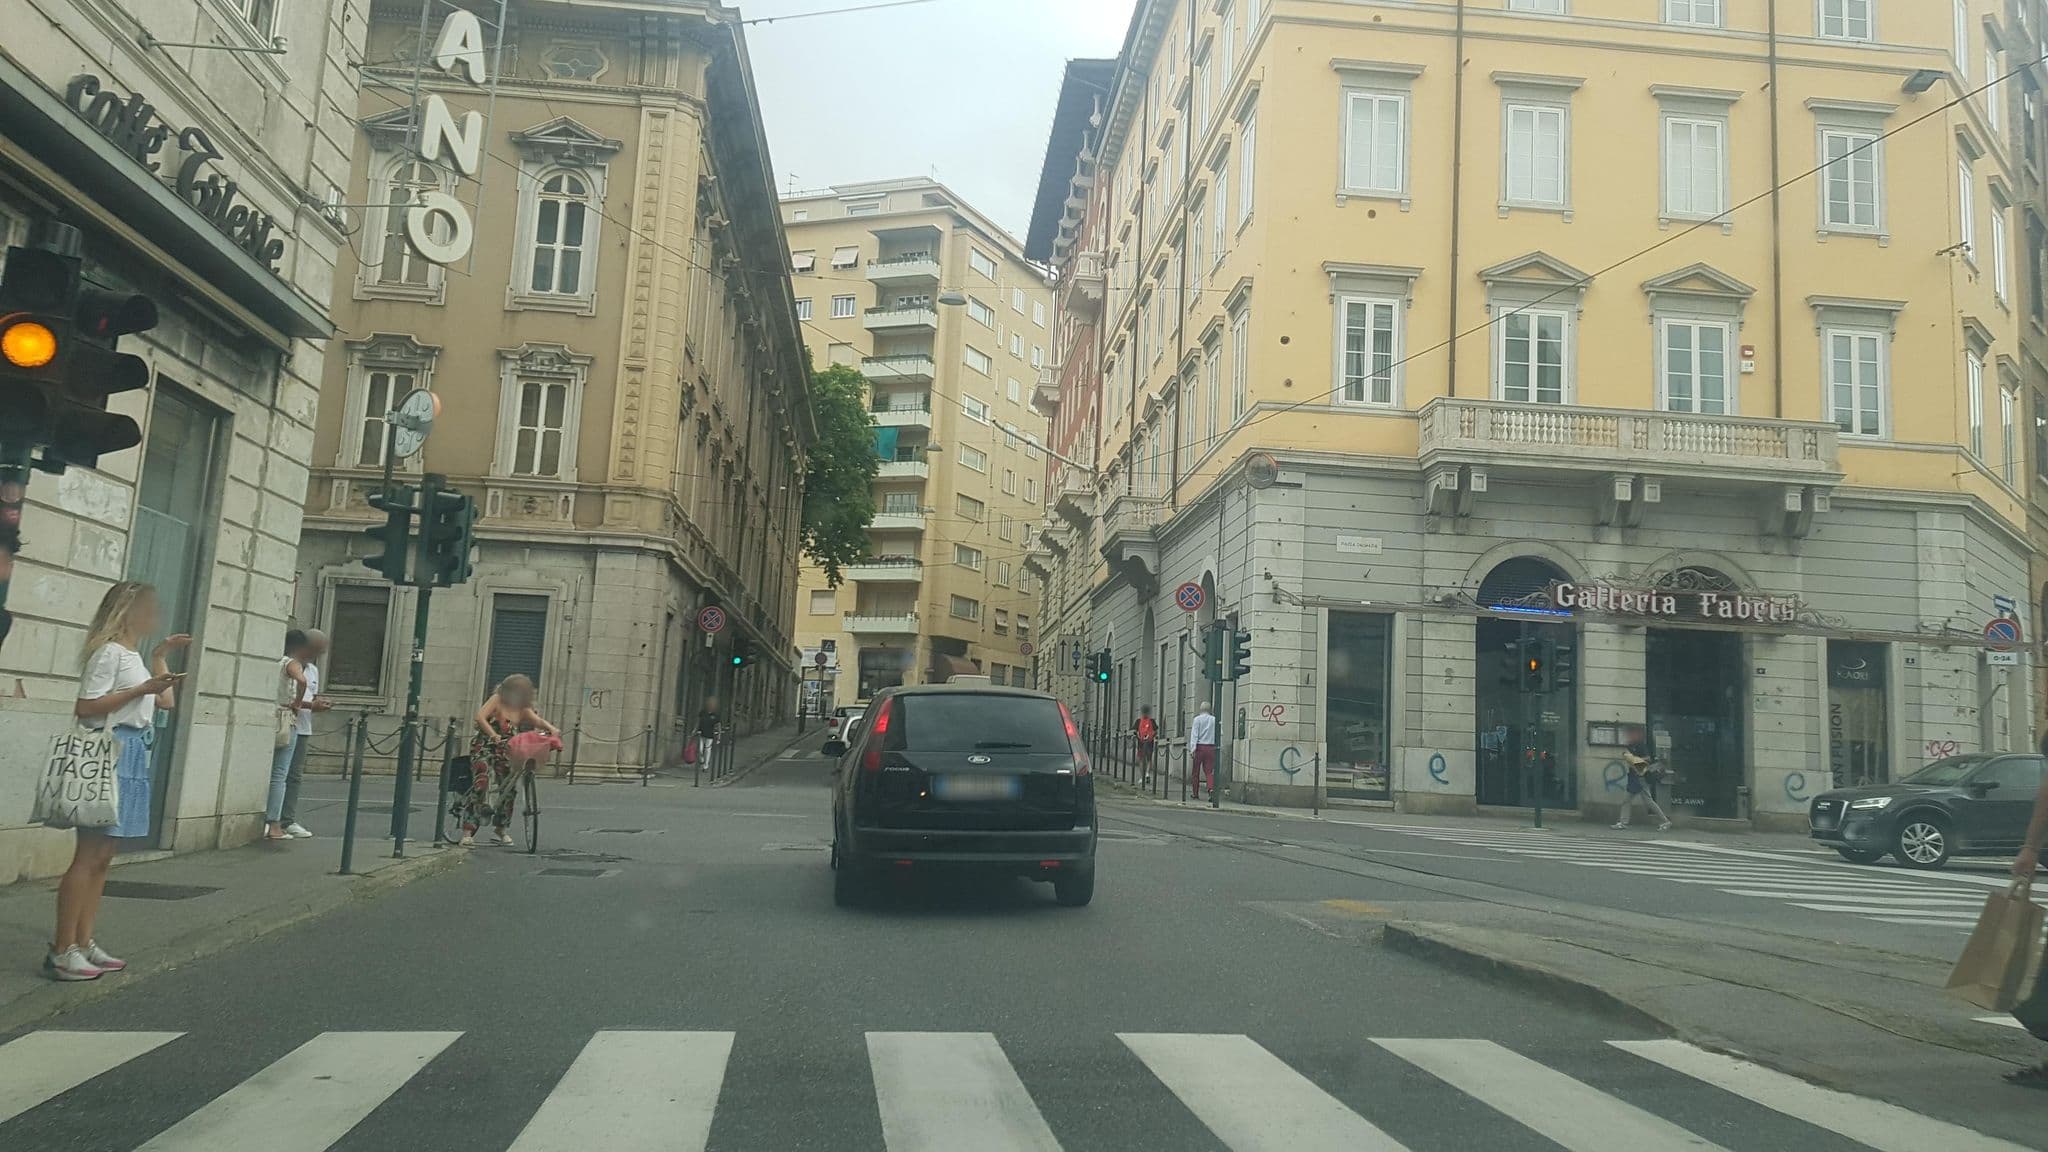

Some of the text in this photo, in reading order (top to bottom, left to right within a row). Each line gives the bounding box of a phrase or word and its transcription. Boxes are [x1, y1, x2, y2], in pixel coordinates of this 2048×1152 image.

[1556, 583, 1677, 614] Galleria
[1700, 592, 1796, 623] Fabris
[53, 734, 112, 759] HERM
[47, 757, 111, 780] ITAGE
[41, 780, 111, 802] MUSE
